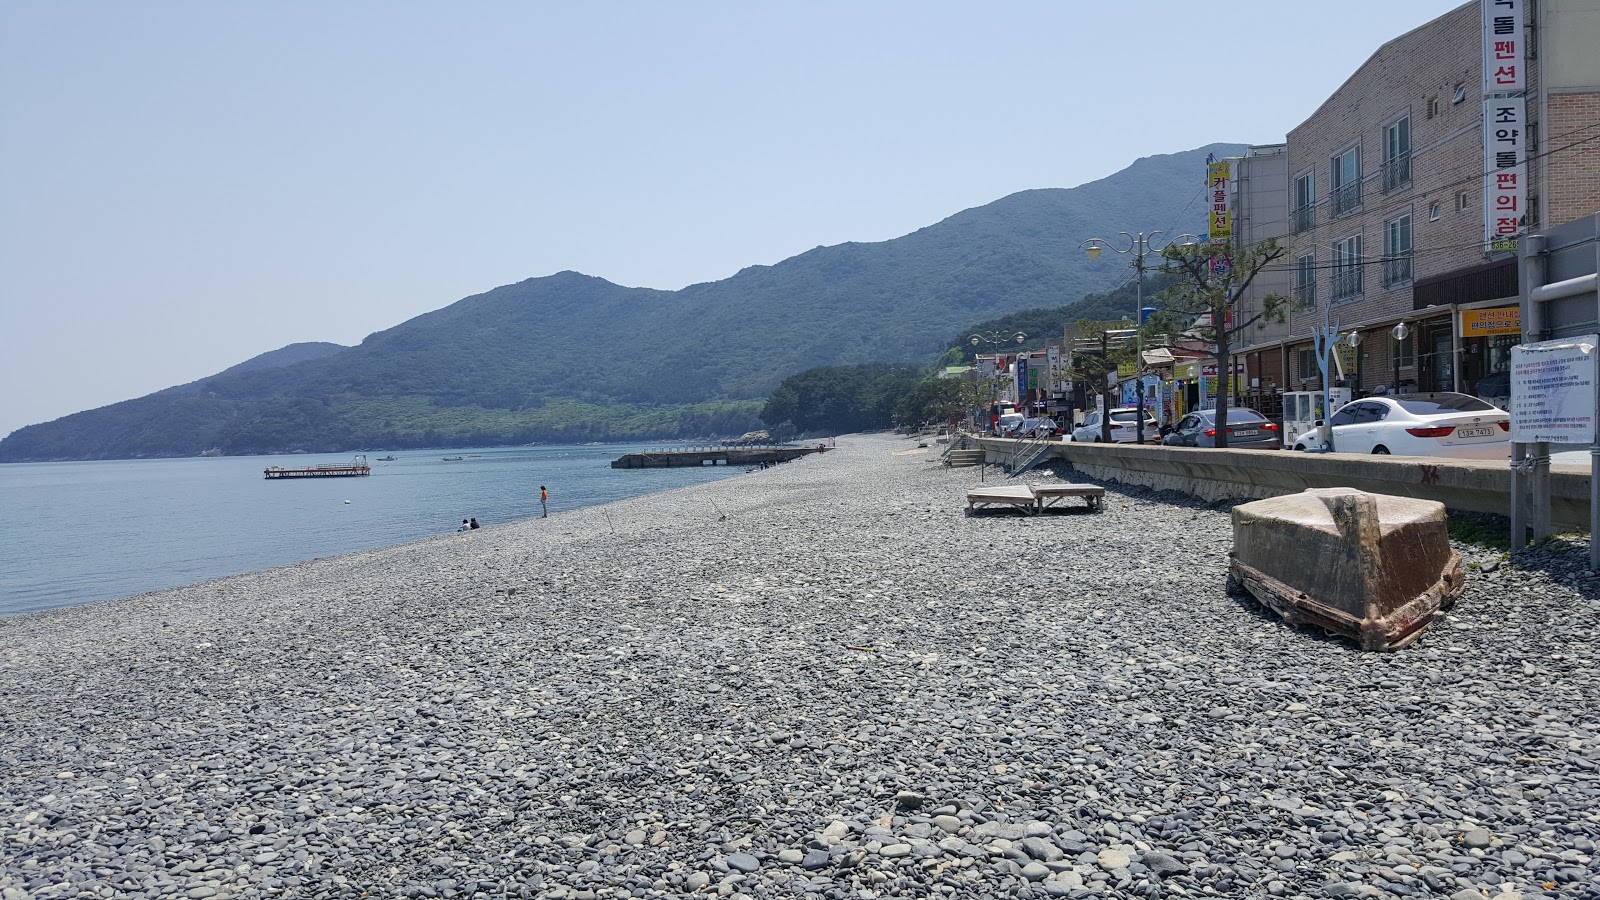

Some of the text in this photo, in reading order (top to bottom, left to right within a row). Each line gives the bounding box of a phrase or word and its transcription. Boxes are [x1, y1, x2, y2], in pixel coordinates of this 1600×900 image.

[1495, 107, 1519, 234] 조약돌편의점
[1213, 176, 1227, 229] 커플펜션
[1471, 321, 1512, 330] 편의점으로
[1479, 311, 1495, 320] 펜션
